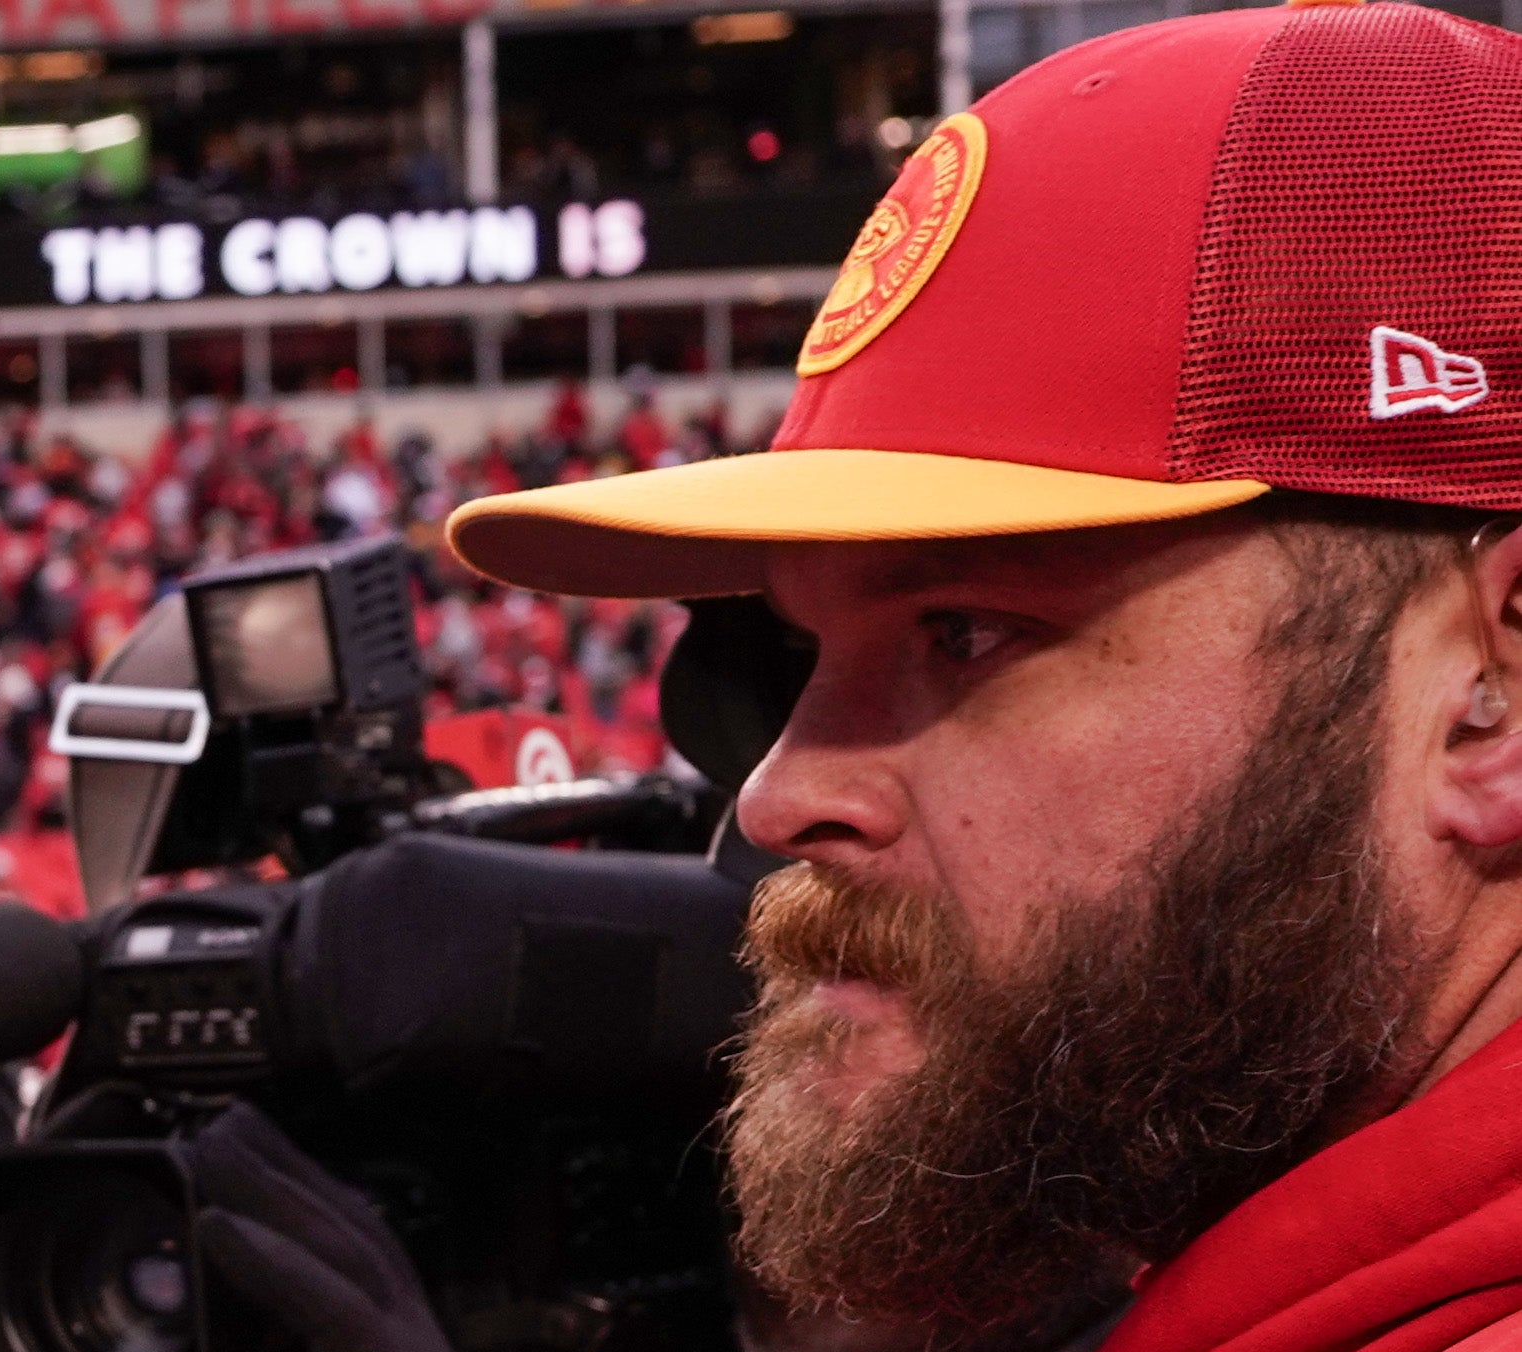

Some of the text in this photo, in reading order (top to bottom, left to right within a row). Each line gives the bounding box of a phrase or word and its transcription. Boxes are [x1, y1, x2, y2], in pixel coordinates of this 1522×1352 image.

[41, 200, 647, 305] THE CROWN IS
[878, 214, 943, 299] LEAGUE
